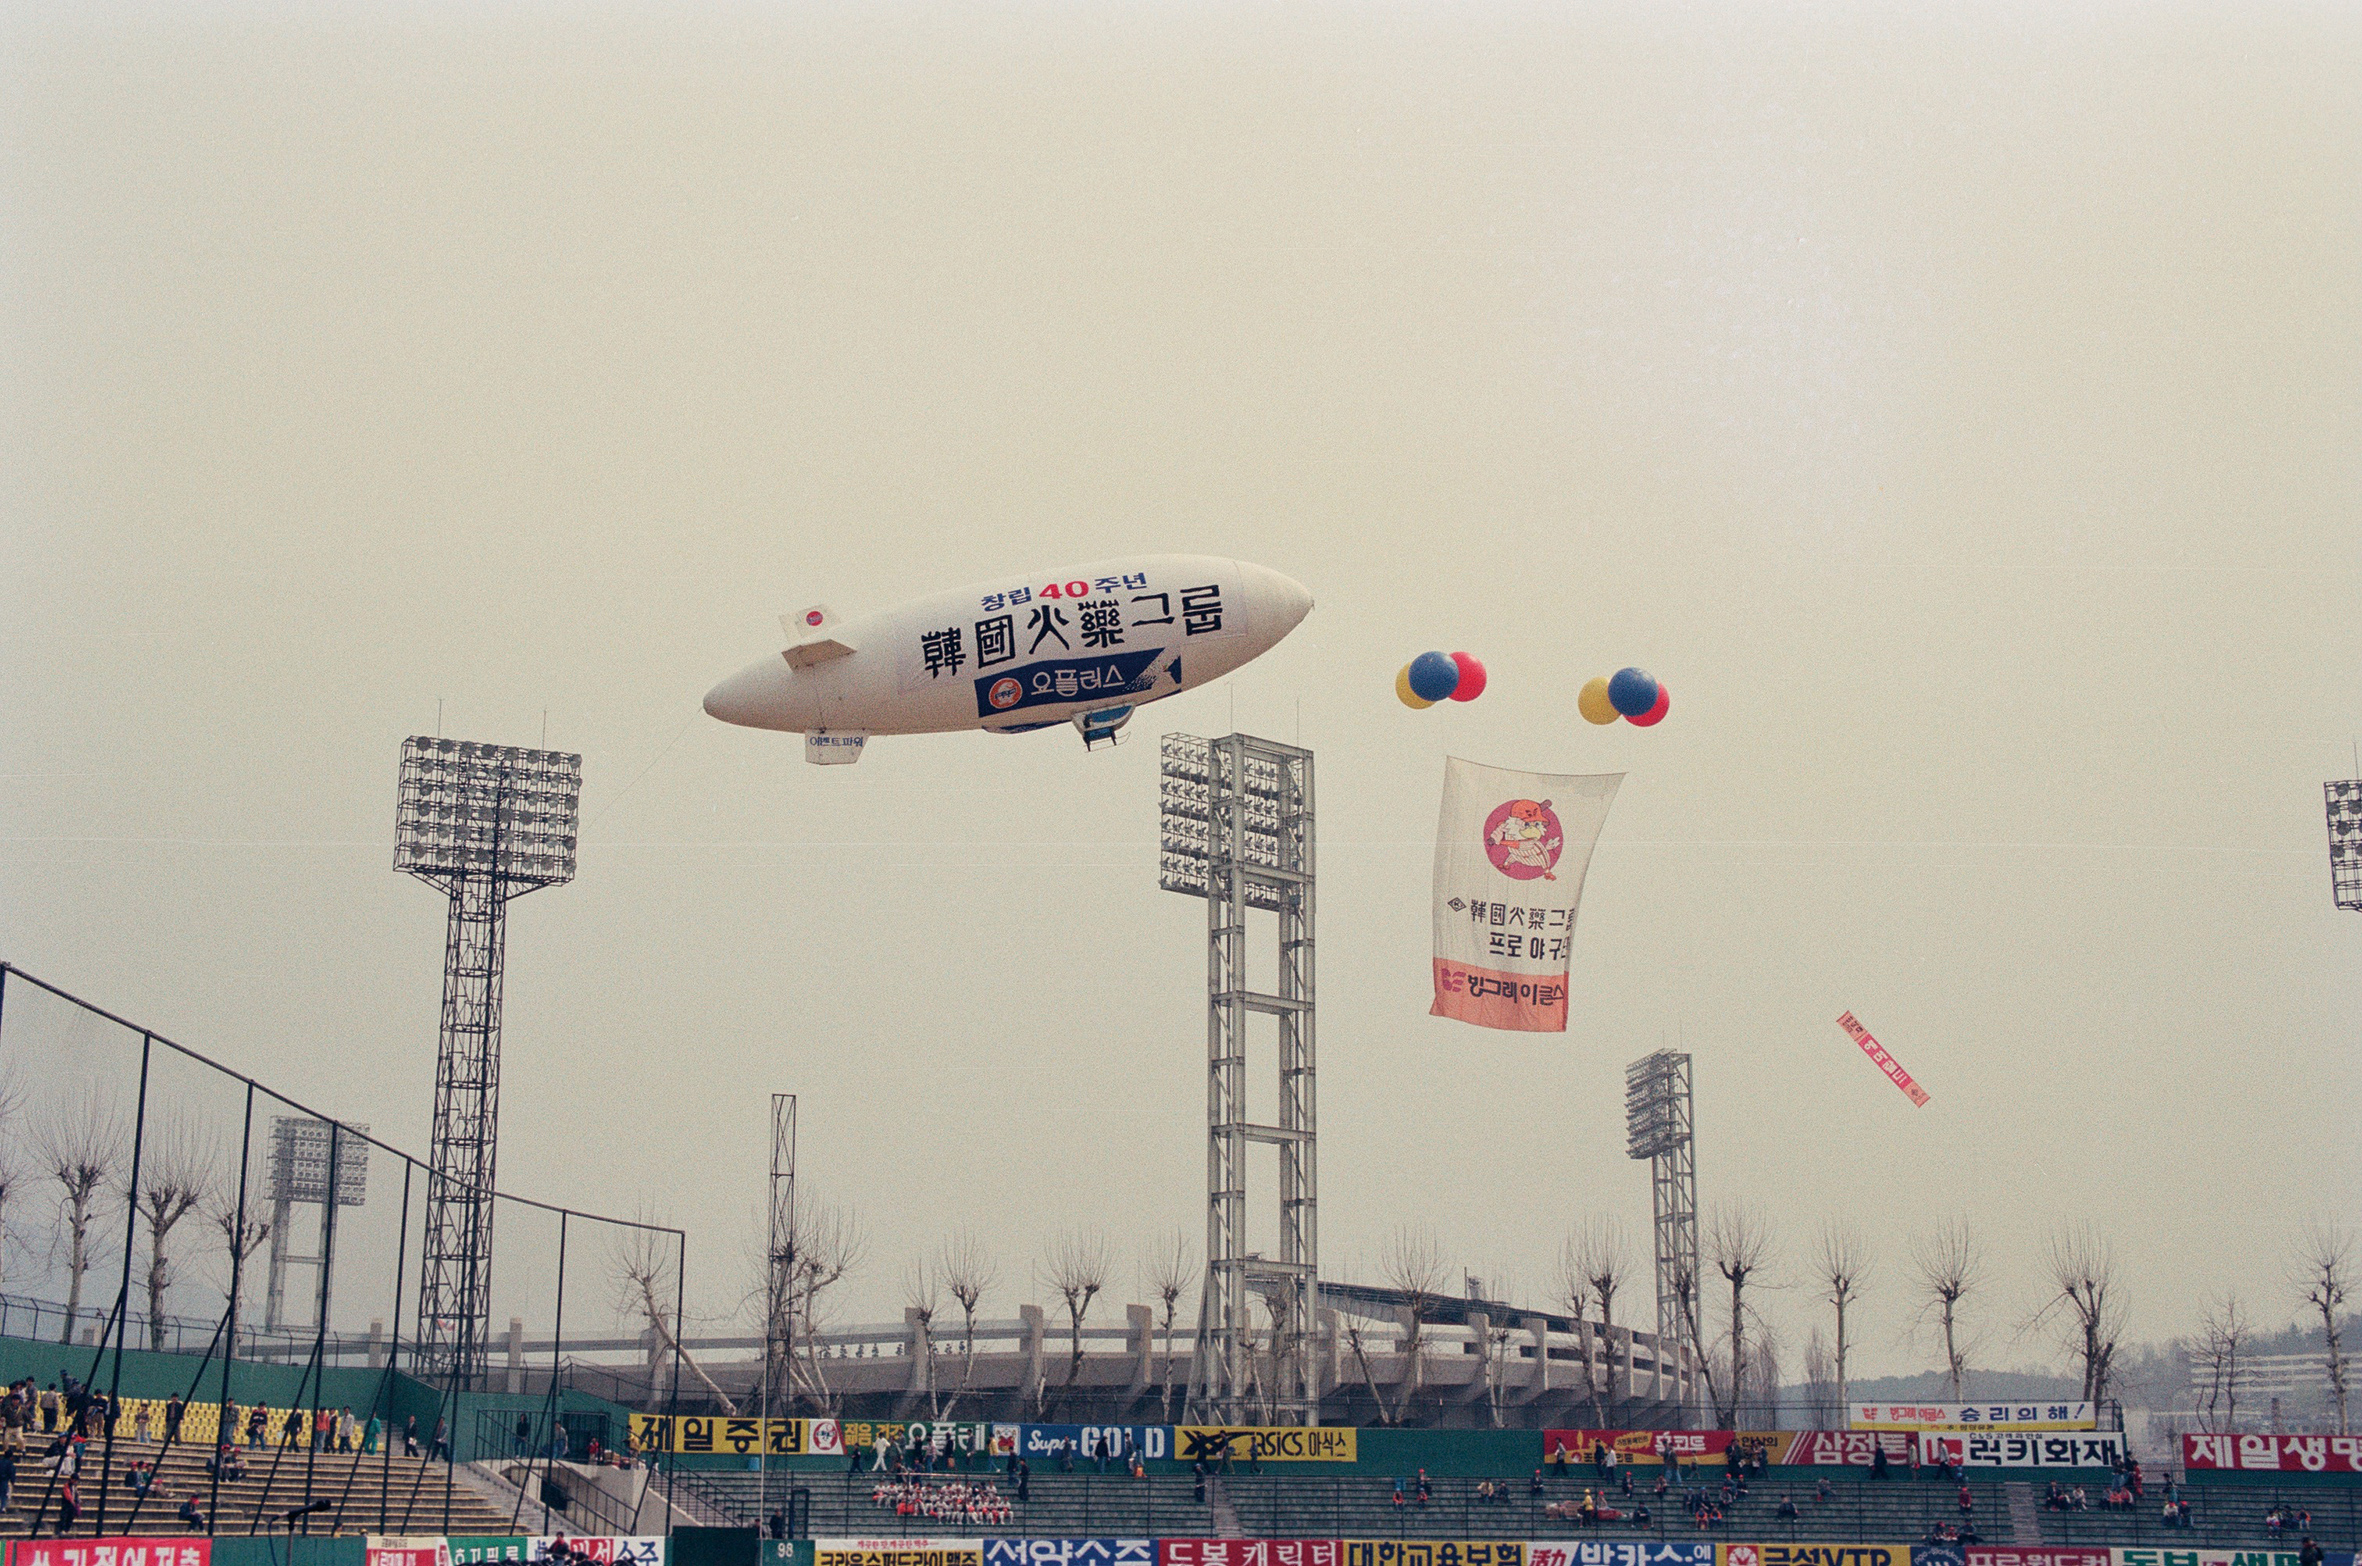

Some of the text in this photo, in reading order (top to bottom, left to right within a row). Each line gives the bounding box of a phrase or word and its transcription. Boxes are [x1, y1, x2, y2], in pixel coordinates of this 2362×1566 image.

[981, 572, 1147, 612] 창립 40 주년
[1489, 932, 1523, 957] 프로
[1468, 975, 1565, 1006] 빙그레 이글스
[1959, 1406, 2037, 1422] 승리의
[2048, 1403, 2085, 1420] 해!
[1308, 1431, 1346, 1457] 아식스
[1969, 1438, 2117, 1466] 럭키화재
[777, 1542, 794, 1558] 98
